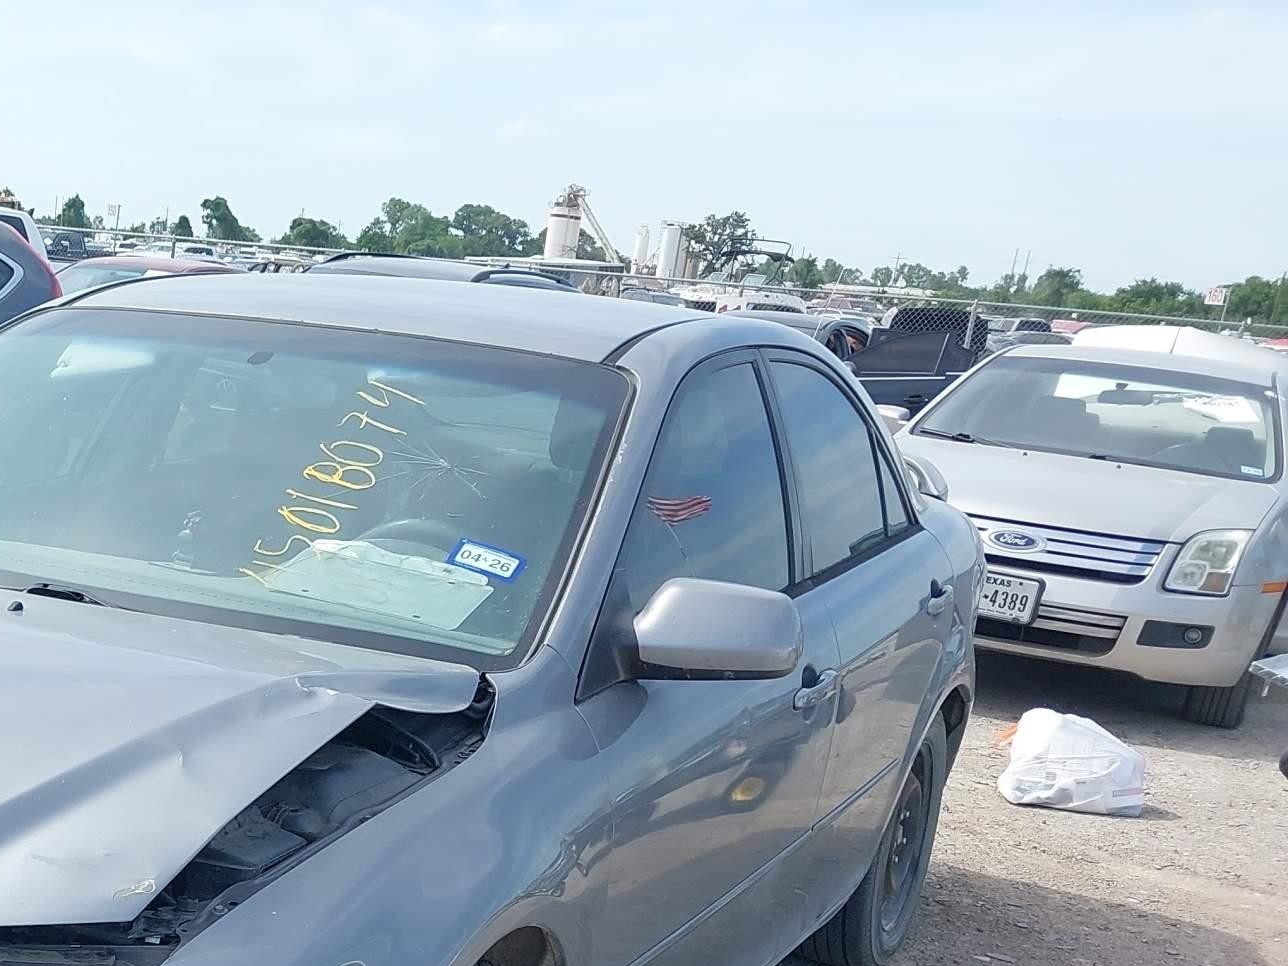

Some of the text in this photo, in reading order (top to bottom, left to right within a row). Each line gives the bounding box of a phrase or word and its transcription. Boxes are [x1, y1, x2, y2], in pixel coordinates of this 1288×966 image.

[999, 532, 1029, 546] Ford
[460, 549, 513, 573] 04 26
[985, 576, 1012, 588] EXAS
